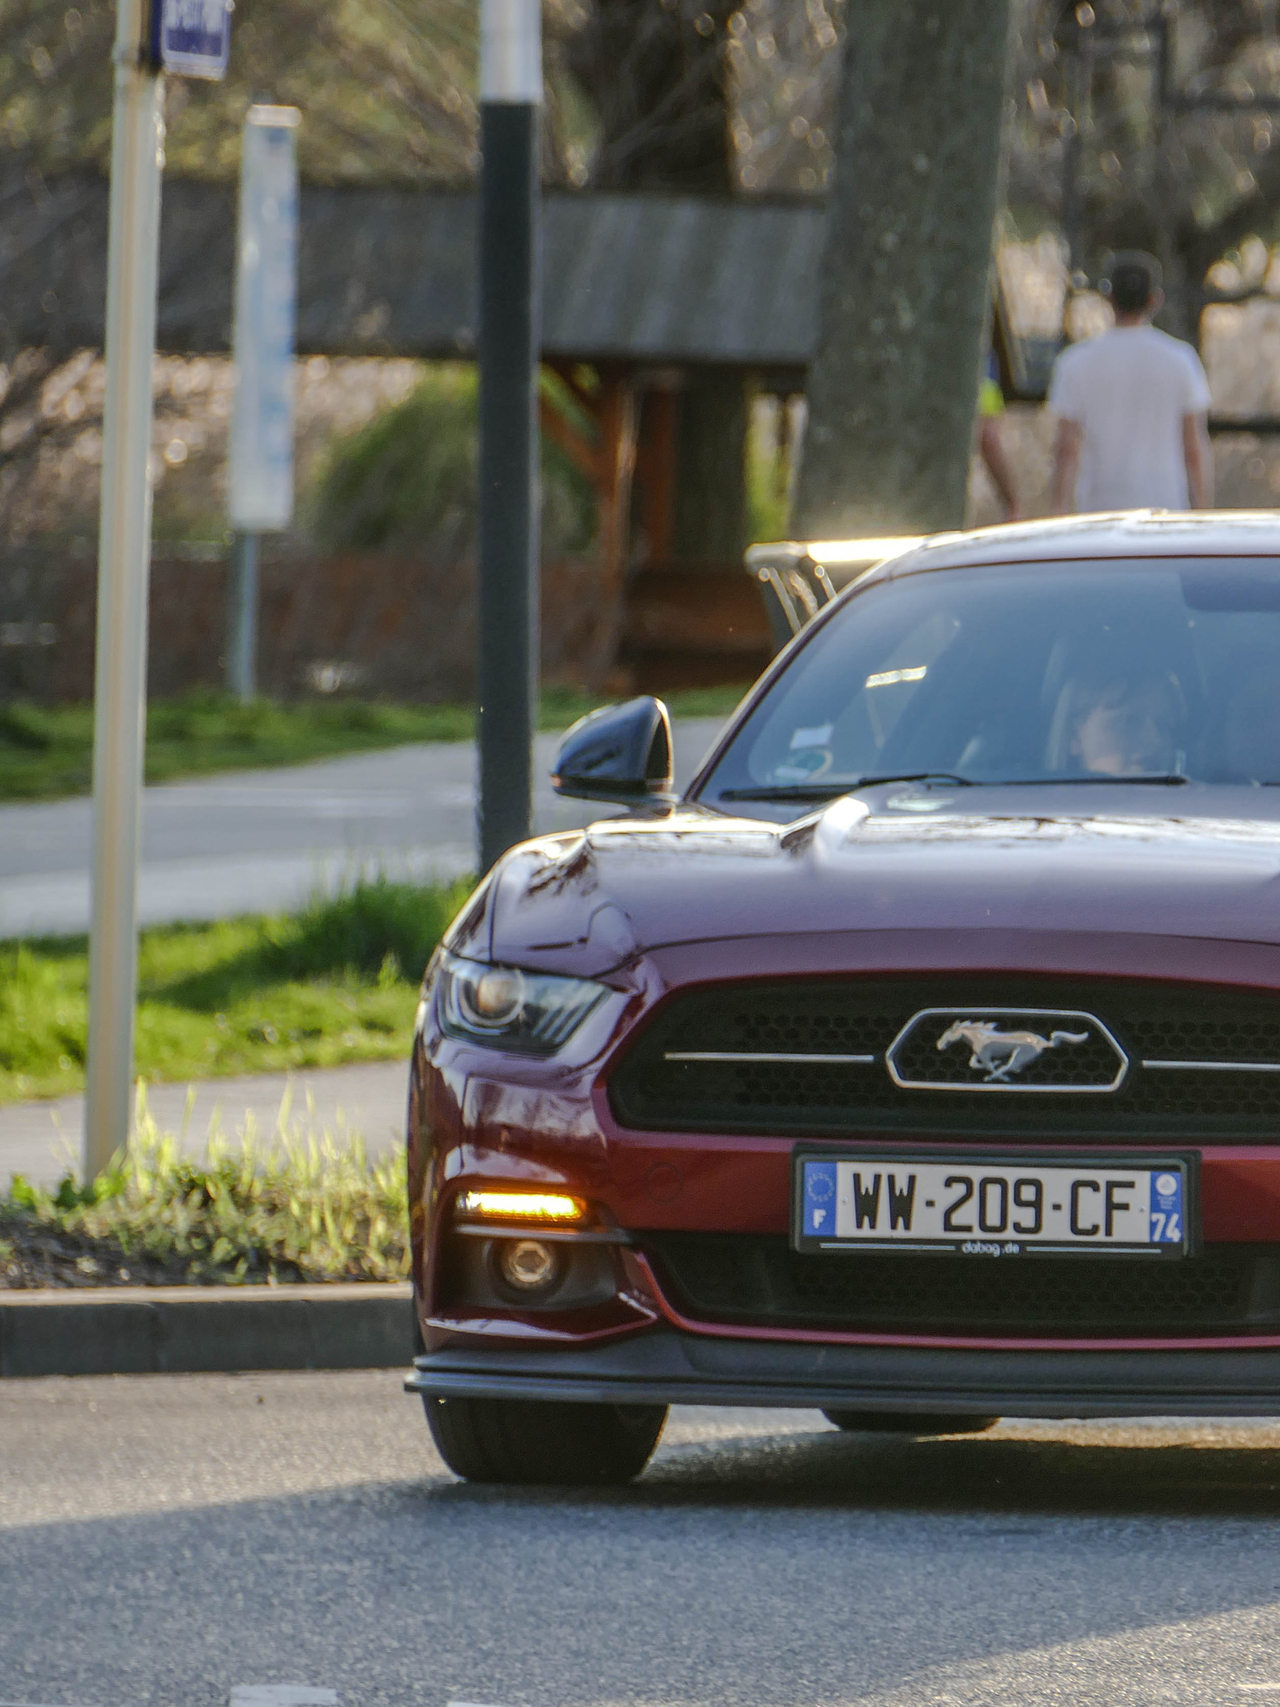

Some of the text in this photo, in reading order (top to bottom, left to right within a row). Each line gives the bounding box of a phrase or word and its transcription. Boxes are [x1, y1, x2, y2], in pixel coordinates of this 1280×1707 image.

[813, 1208, 827, 1229] F
[853, 1173, 1136, 1237] WW-209-CF
[1151, 1212, 1182, 1242] 74
